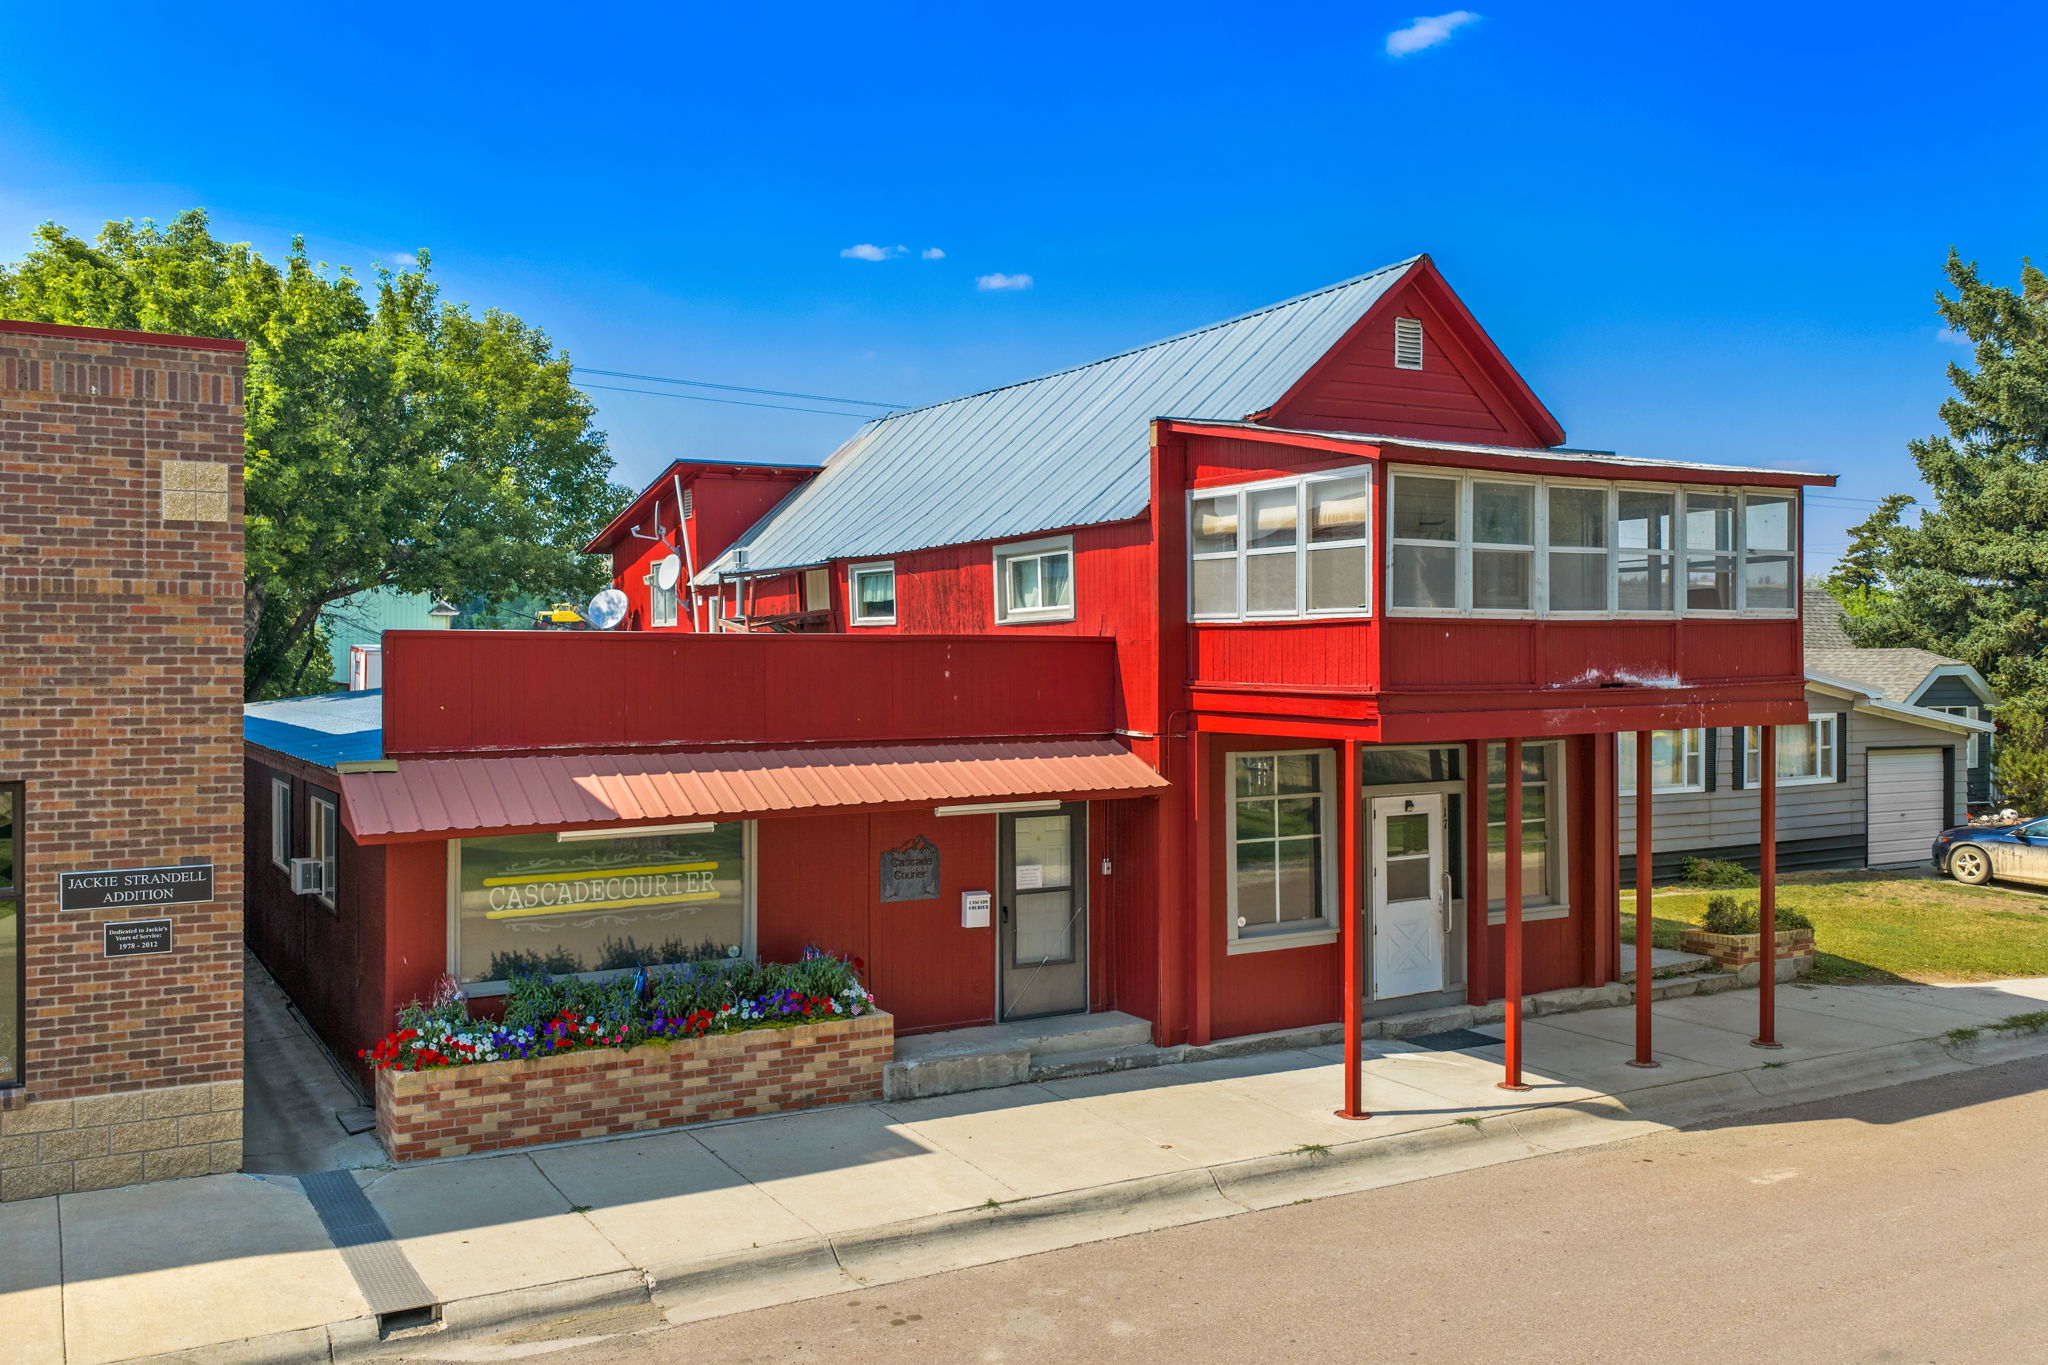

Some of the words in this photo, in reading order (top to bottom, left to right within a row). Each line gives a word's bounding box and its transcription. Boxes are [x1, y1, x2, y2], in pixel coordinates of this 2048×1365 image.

[891, 856, 933, 868] Cascade
[68, 876, 119, 890] JACKIE
[124, 871, 207, 886] STRANDELL
[894, 869, 927, 881] Courier
[103, 888, 174, 903] ADDITION
[119, 942, 136, 950] 1978
[141, 941, 158, 949] 2012
